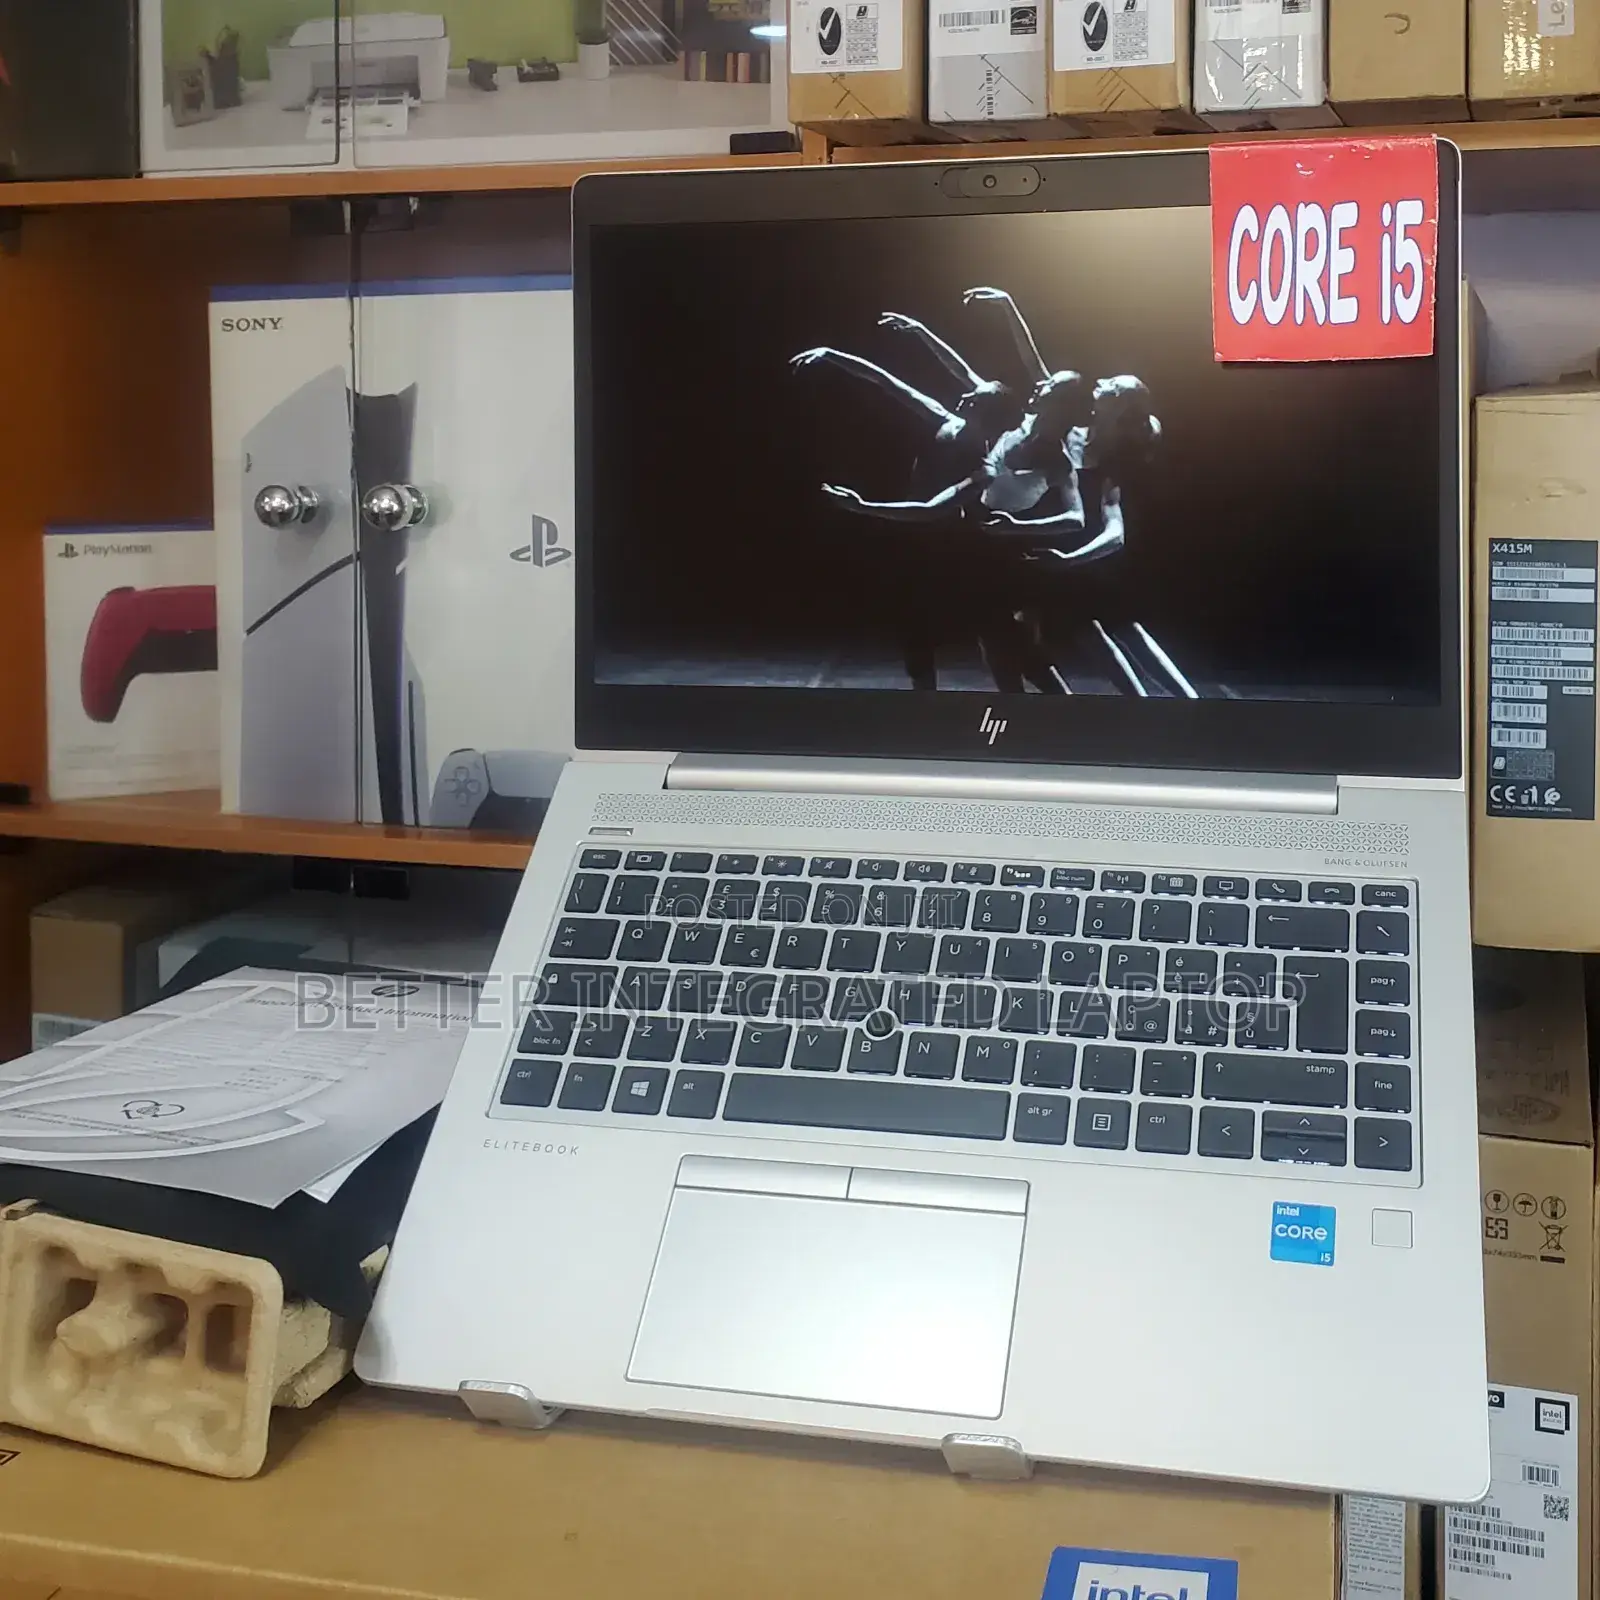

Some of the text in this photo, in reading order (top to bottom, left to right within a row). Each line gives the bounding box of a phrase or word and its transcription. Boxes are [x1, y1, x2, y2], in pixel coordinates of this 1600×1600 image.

[1228, 200, 1424, 326] CORE i5
[221, 317, 282, 332] SONY
[84, 544, 152, 557] PlayStation
[1324, 858, 1351, 867] BANG
[1375, 889, 1397, 897] canc
[717, 900, 726, 910] 3
[768, 902, 777, 912] 4
[821, 905, 830, 915] 5
[874, 907, 883, 917] 6
[982, 912, 992, 923] 8
[1037, 916, 1047, 926] 9
[631, 929, 644, 939] Q
[685, 931, 700, 942] W
[734, 933, 745, 944] E
[787, 936, 797, 946] R
[841, 938, 850, 949] T
[896, 941, 906, 951] Y
[950, 944, 961, 955] U
[1118, 954, 1129, 966] P
[630, 975, 642, 986] A
[683, 978, 693, 989] S
[735, 981, 747, 992] D
[788, 984, 799, 994] F
[845, 987, 856, 997] G
[900, 989, 911, 1000] H
[954, 993, 964, 1004] J
[1012, 997, 1023, 1009] K
[1070, 1001, 1079, 1013] L
[641, 1026, 653, 1037] Z
[1143, 1020, 1158, 1032] @
[695, 1029, 708, 1040] X
[750, 1032, 762, 1043] C
[807, 1035, 819, 1046] V
[860, 1041, 872, 1053] B
[918, 1042, 930, 1054] N
[976, 1046, 990, 1058] M
[516, 1070, 531, 1078] ctrl
[1306, 1064, 1336, 1075] stamp
[573, 1074, 583, 1083] fn
[682, 1082, 695, 1090] alt
[1374, 1080, 1393, 1090] fine
[1027, 1106, 1052, 1117] alt gr
[1149, 1115, 1166, 1124] ctrl
[483, 1139, 580, 1155] ELITEBOOK
[1276, 1205, 1300, 1216] intel
[1320, 1252, 1331, 1262] i5
[1542, 1408, 1562, 1419] intel
